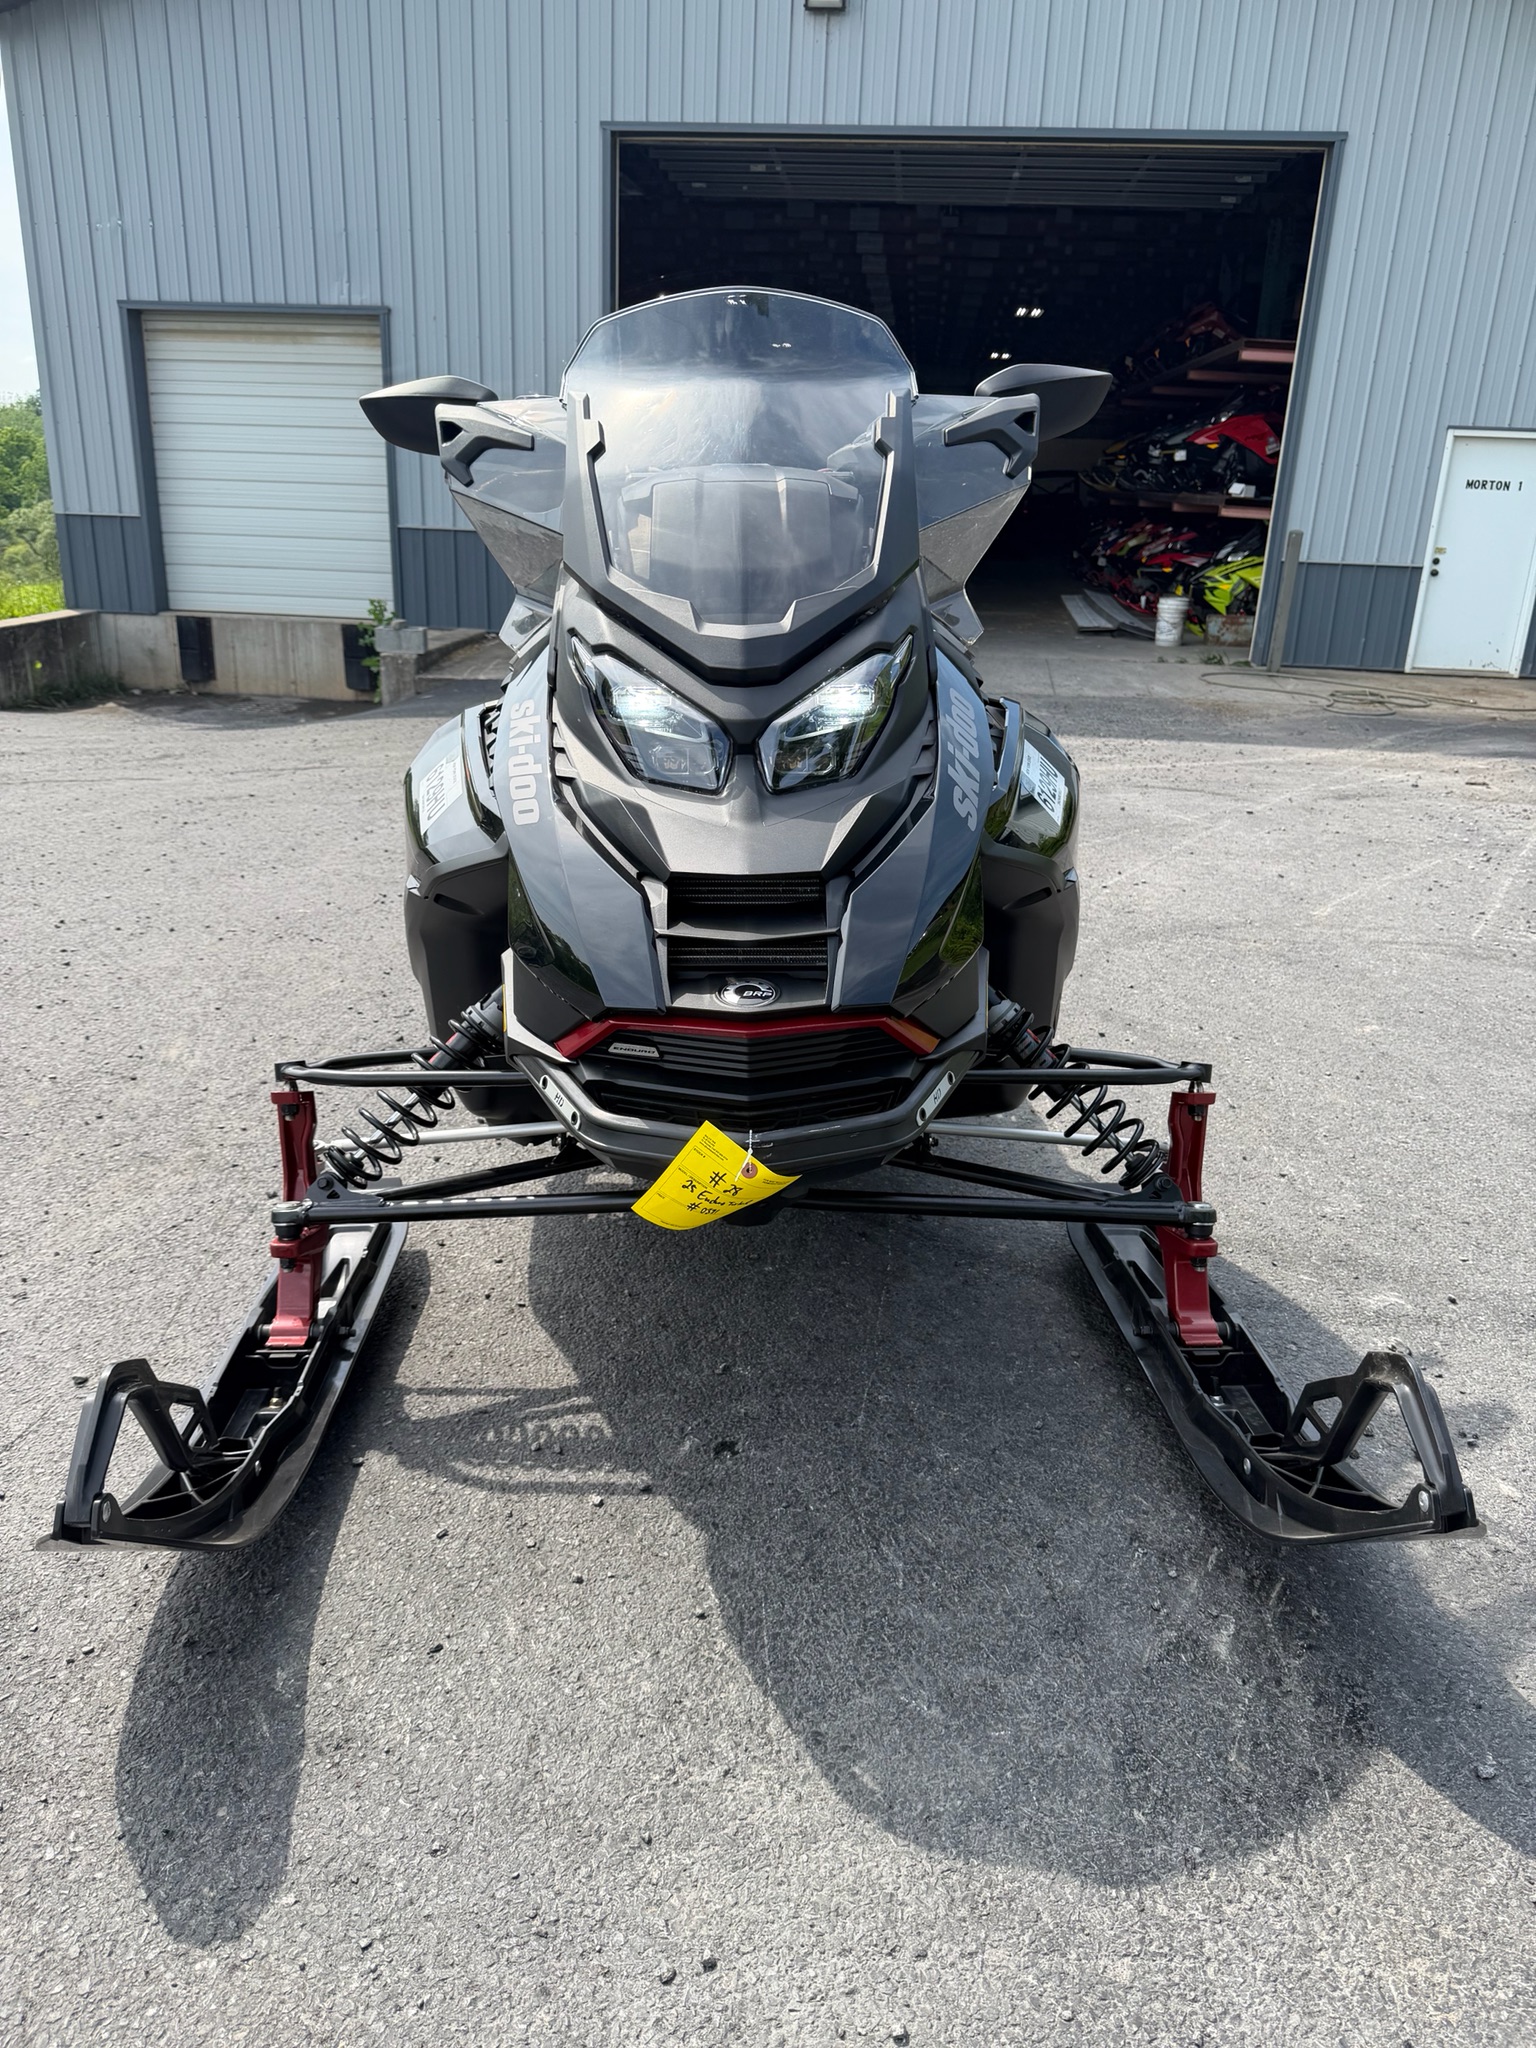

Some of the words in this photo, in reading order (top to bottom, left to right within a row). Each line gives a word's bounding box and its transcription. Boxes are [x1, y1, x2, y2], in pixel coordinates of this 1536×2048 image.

[1465, 479, 1511, 491] MORTON
[1518, 481, 1523, 491] 1
[509, 699, 542, 826] ski-doo
[945, 687, 980, 832] ski-doo
[613, 1046, 656, 1054] ENDURO
[554, 1092, 565, 1107] HD
[933, 1087, 942, 1105] HD
[682, 1180, 697, 1193] 25
[709, 1171, 727, 1188] #
[723, 1184, 743, 1196] 28
[687, 1202, 702, 1211] #
